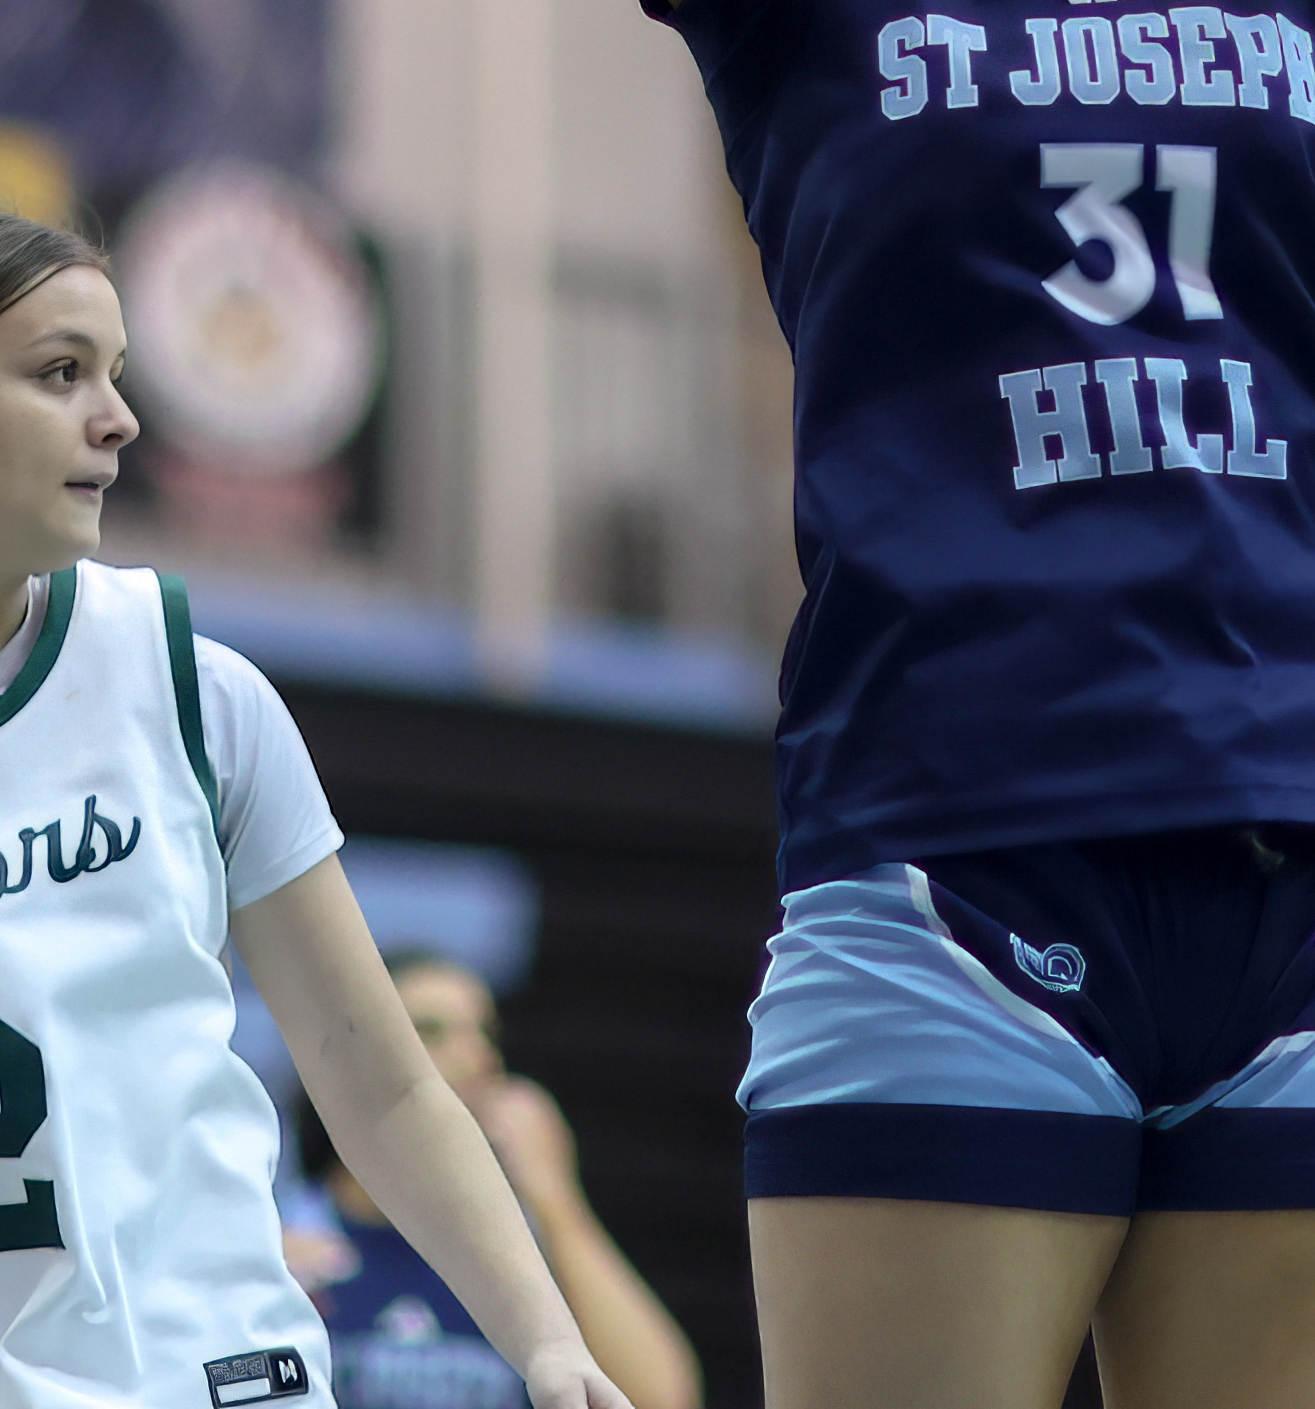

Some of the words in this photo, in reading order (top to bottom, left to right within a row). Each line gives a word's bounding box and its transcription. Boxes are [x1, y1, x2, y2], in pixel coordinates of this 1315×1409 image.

[877, 13, 987, 121] ST
[1039, 142, 1224, 326] 31
[998, 357, 1288, 490] HILL
